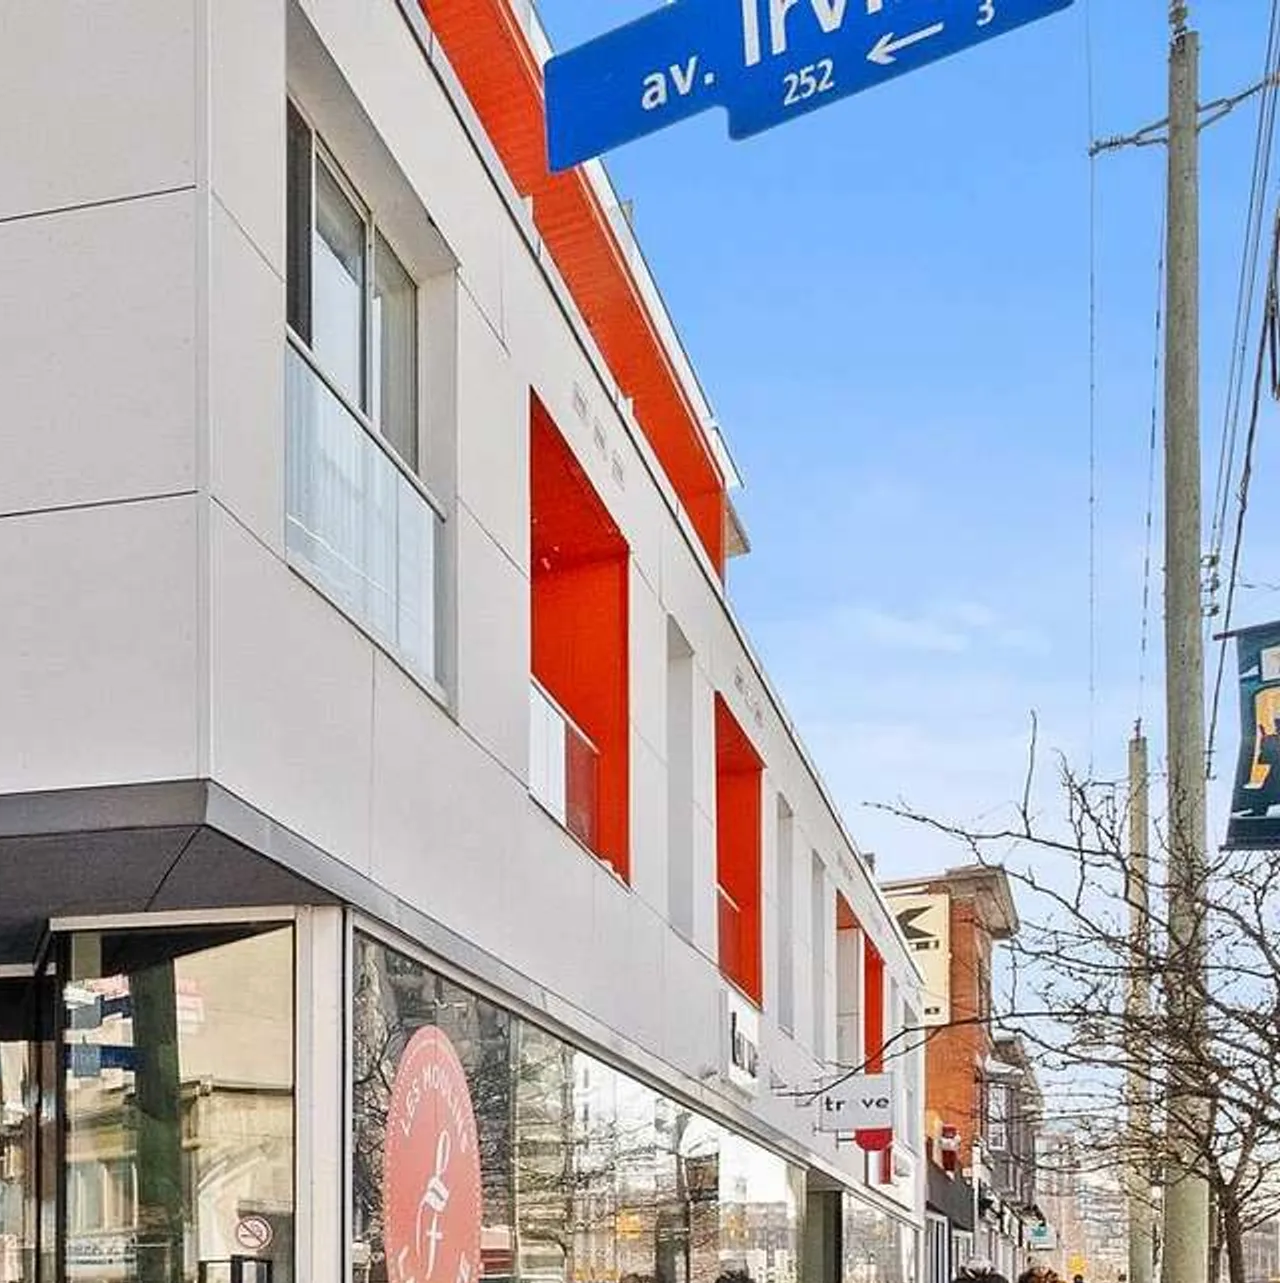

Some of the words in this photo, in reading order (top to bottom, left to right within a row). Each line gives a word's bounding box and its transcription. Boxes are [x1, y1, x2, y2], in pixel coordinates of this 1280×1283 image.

[641, 56, 715, 110] av.
[741, 0, 884, 66] Irv
[783, 59, 835, 106] 252
